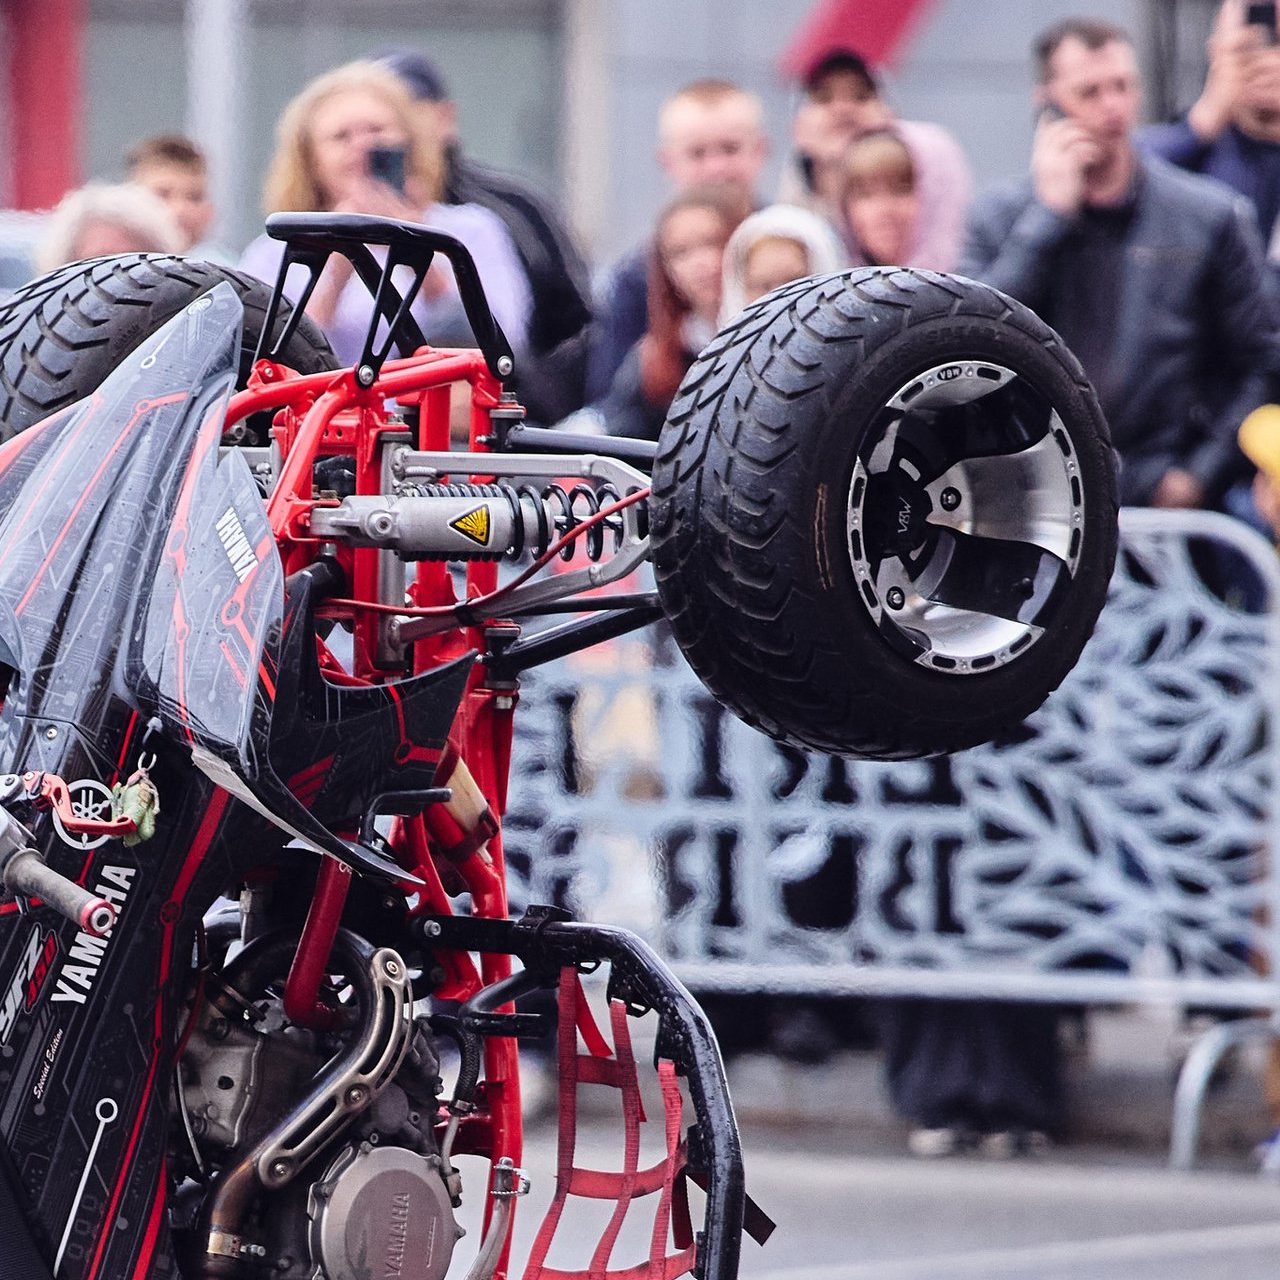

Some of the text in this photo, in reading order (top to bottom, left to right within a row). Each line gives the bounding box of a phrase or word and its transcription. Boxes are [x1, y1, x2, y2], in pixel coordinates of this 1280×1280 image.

[938, 367, 961, 381] VBW
[215, 506, 259, 584] YAMAHA
[50, 864, 136, 1005] YAMHA
[33, 1028, 64, 1100] Special Edition
[384, 1192, 410, 1277] YAMAHA
